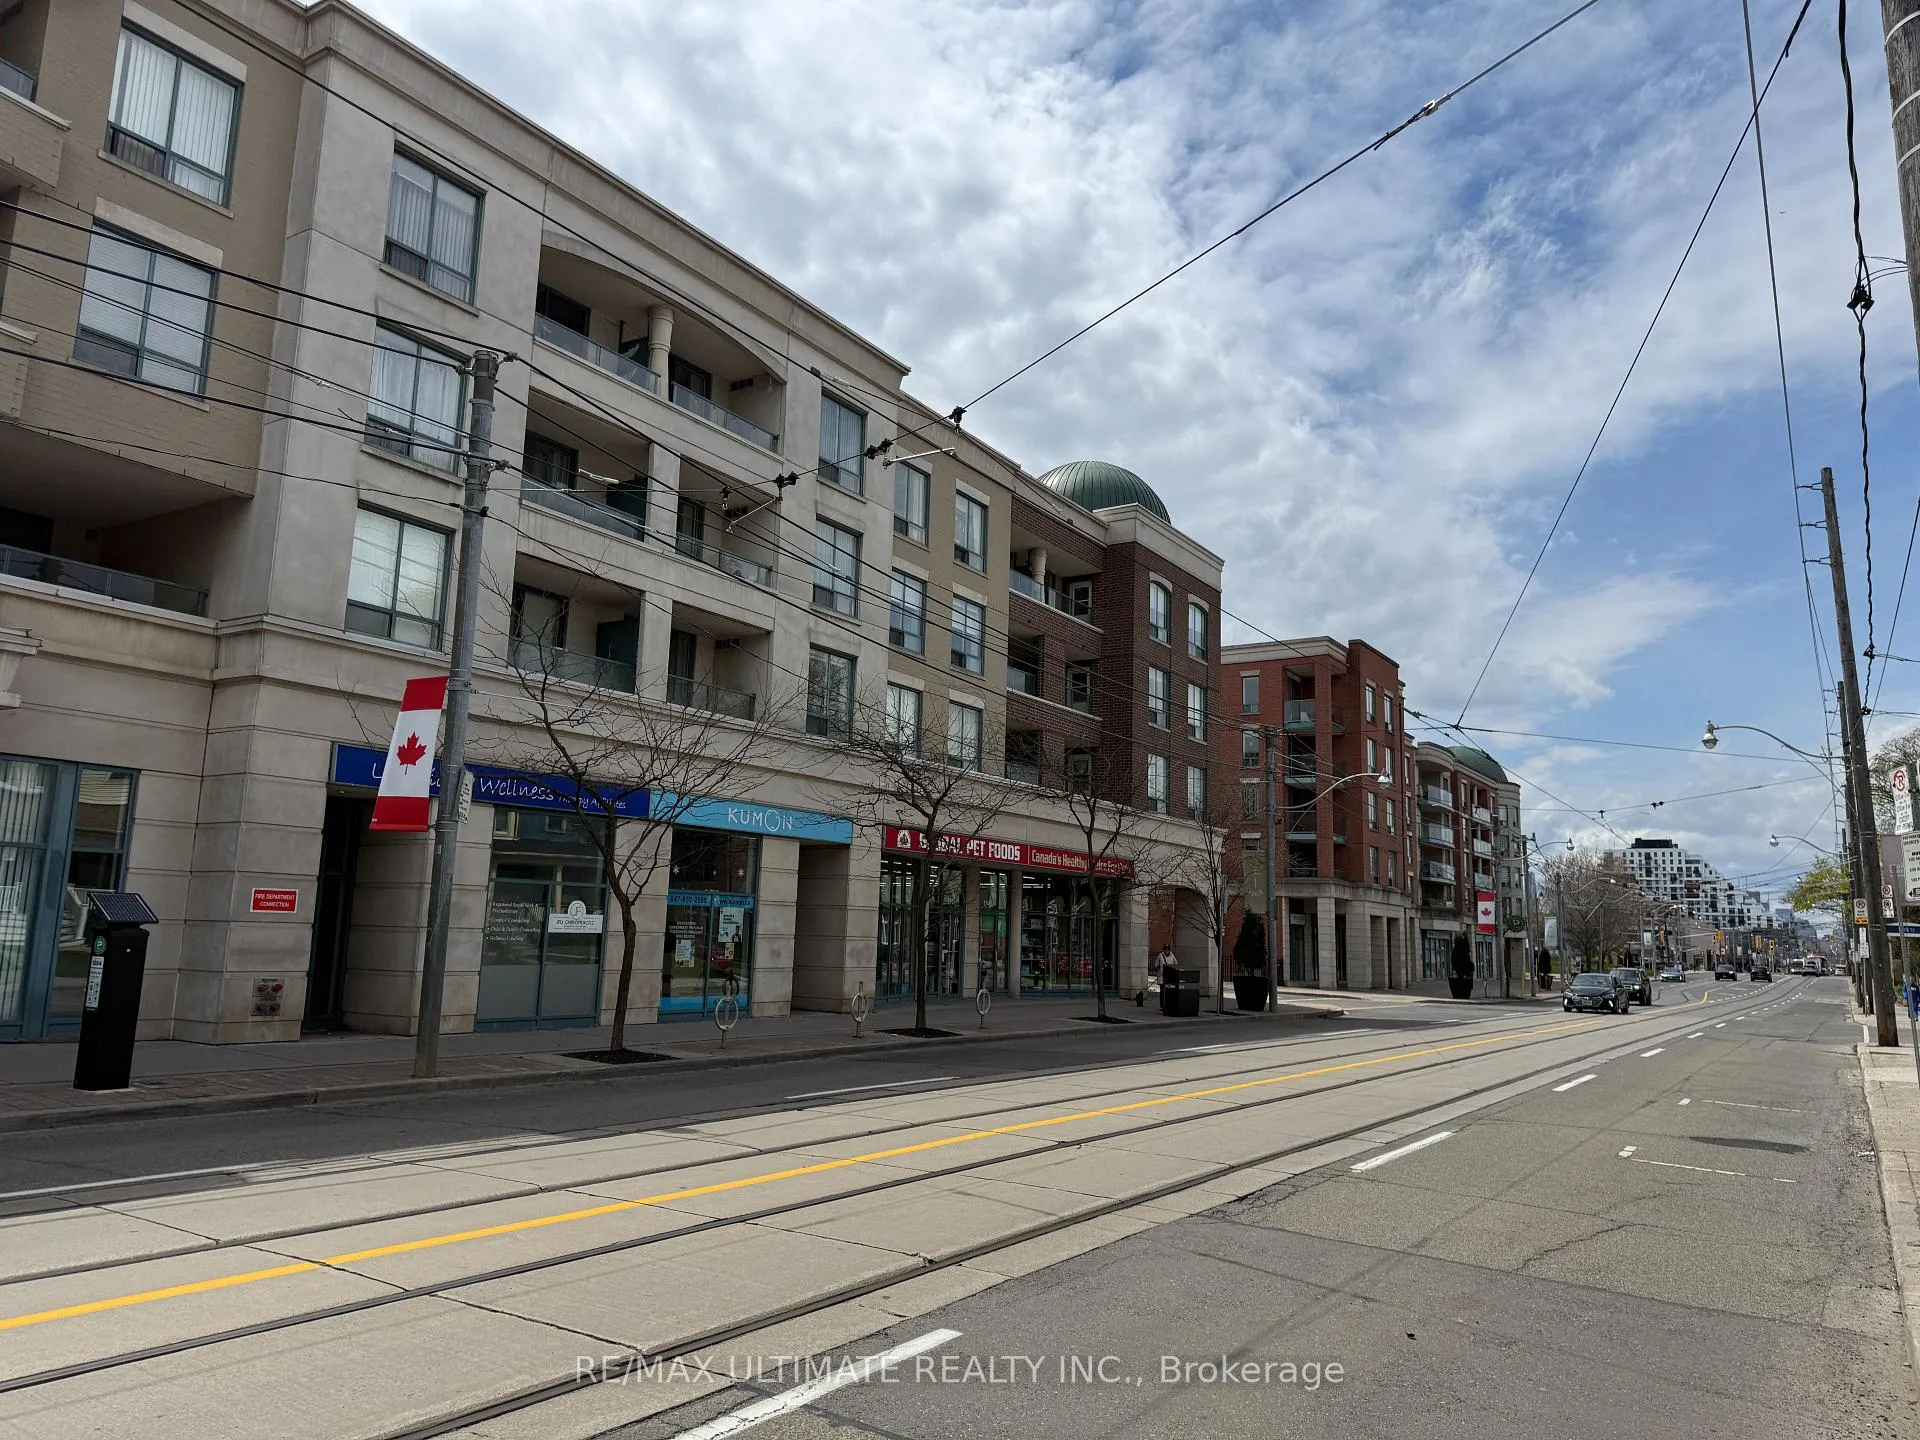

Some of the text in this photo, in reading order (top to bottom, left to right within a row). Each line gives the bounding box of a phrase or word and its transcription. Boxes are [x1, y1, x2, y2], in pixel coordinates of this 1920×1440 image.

[480, 778, 554, 801] Wellness
[728, 807, 793, 832] KUMON
[919, 831, 1021, 861] GBAL PET FOODS
[1031, 849, 1062, 867] Canada's
[1062, 854, 1087, 872] Healthy
